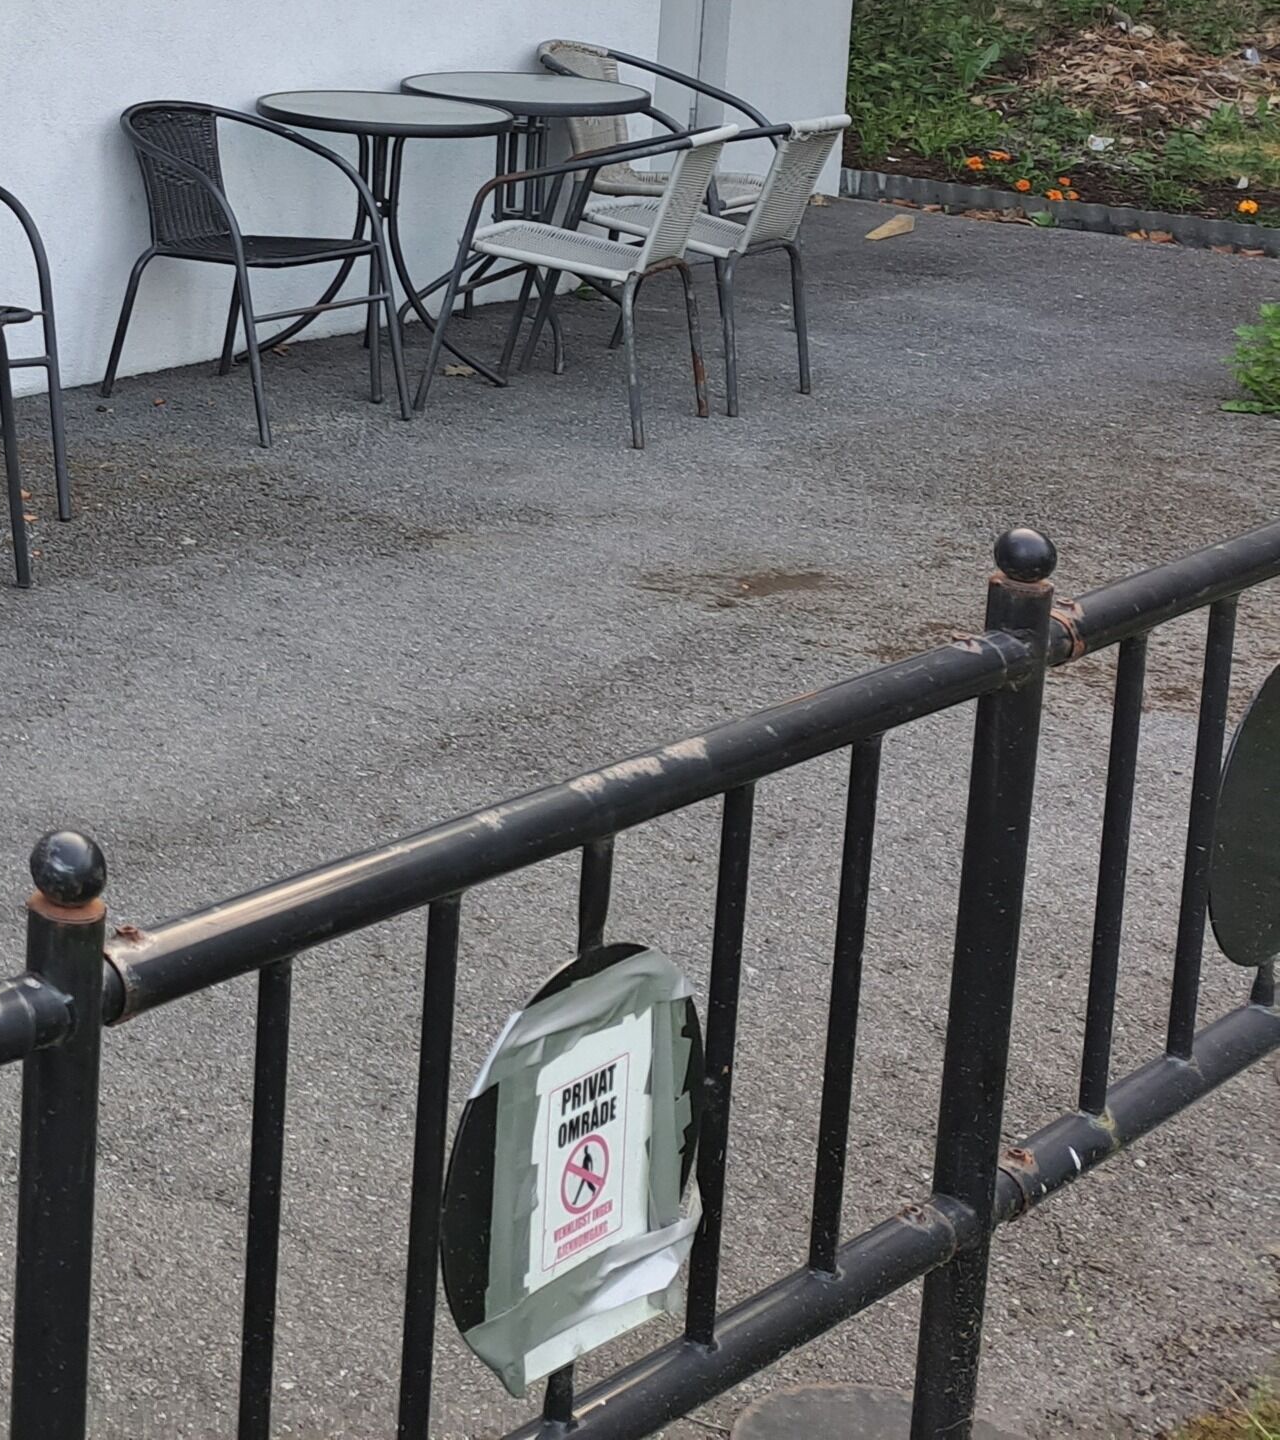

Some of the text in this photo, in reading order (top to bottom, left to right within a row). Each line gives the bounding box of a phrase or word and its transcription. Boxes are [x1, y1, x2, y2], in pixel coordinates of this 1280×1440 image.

[561, 1063, 617, 1117] PRIVAT
[558, 1096, 618, 1149] OMRÅDE
[592, 1198, 613, 1222] INGEN
